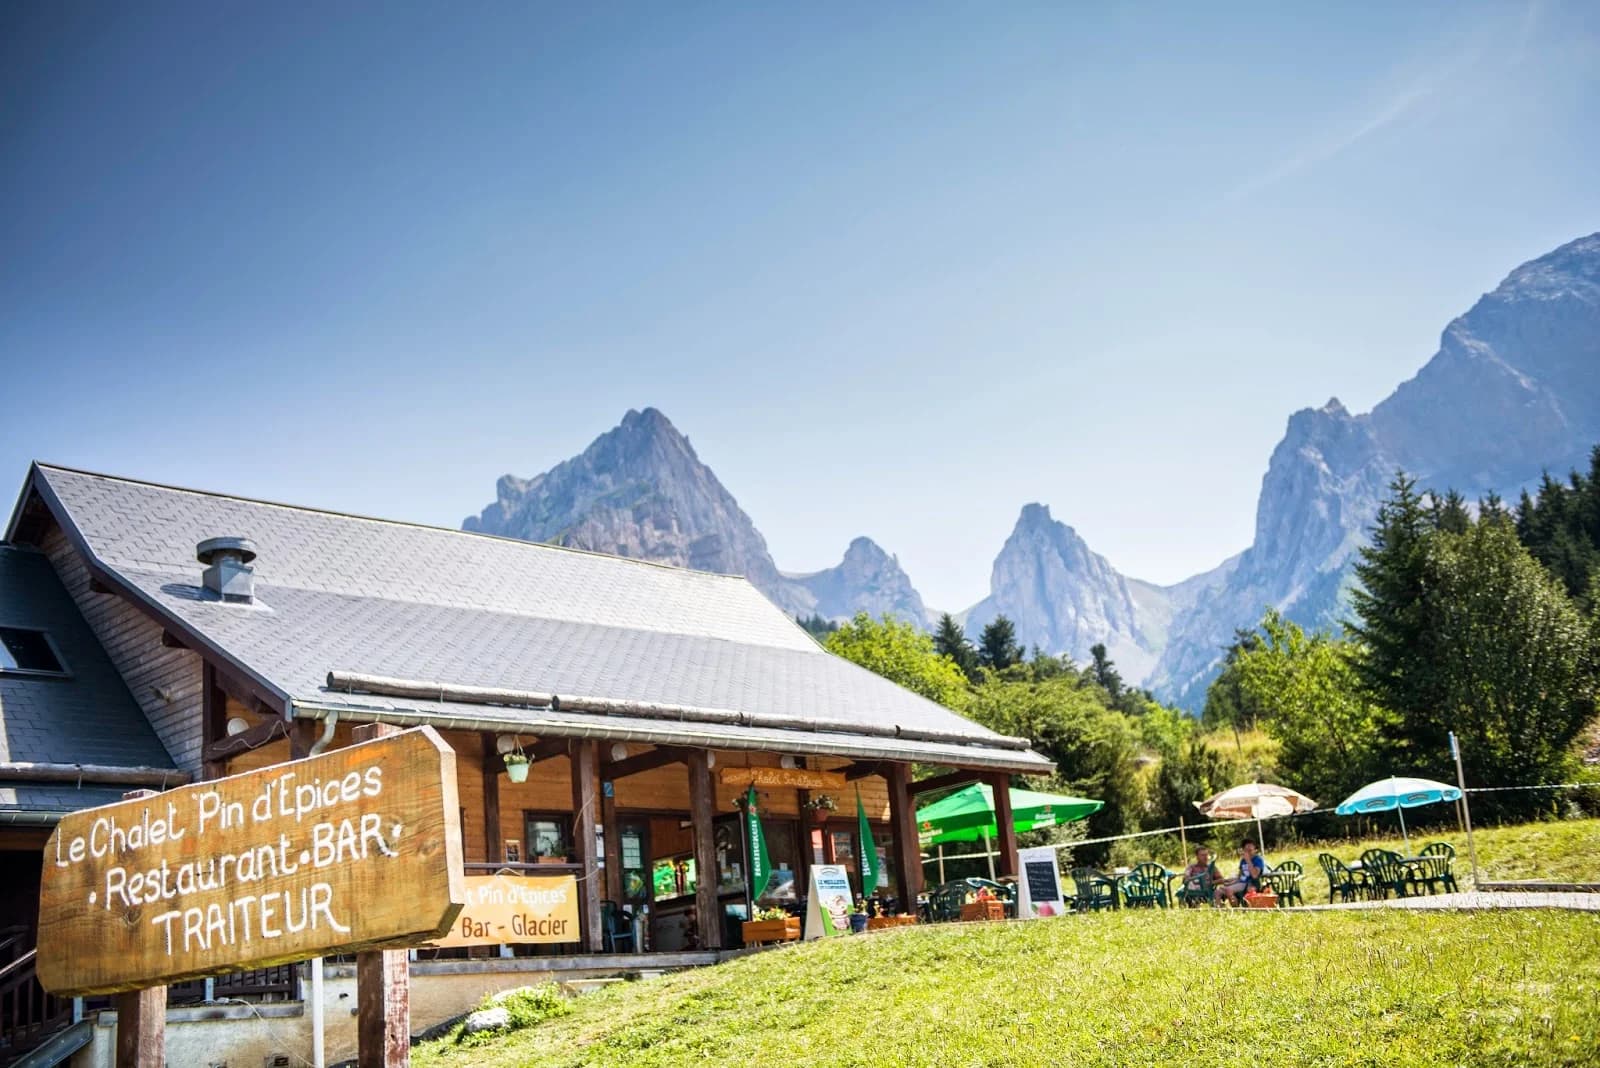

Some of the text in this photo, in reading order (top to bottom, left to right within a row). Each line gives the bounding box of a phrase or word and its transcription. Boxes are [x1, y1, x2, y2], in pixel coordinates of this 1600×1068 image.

[55, 766, 383, 868] Le Chalet Pin d'Epices
[751, 820, 762, 877] Heineken
[151, 882, 350, 956] TRAITEUR
[478, 884, 503, 905] Pin
[461, 916, 491, 938] Bar
[511, 912, 568, 937] Glacier
